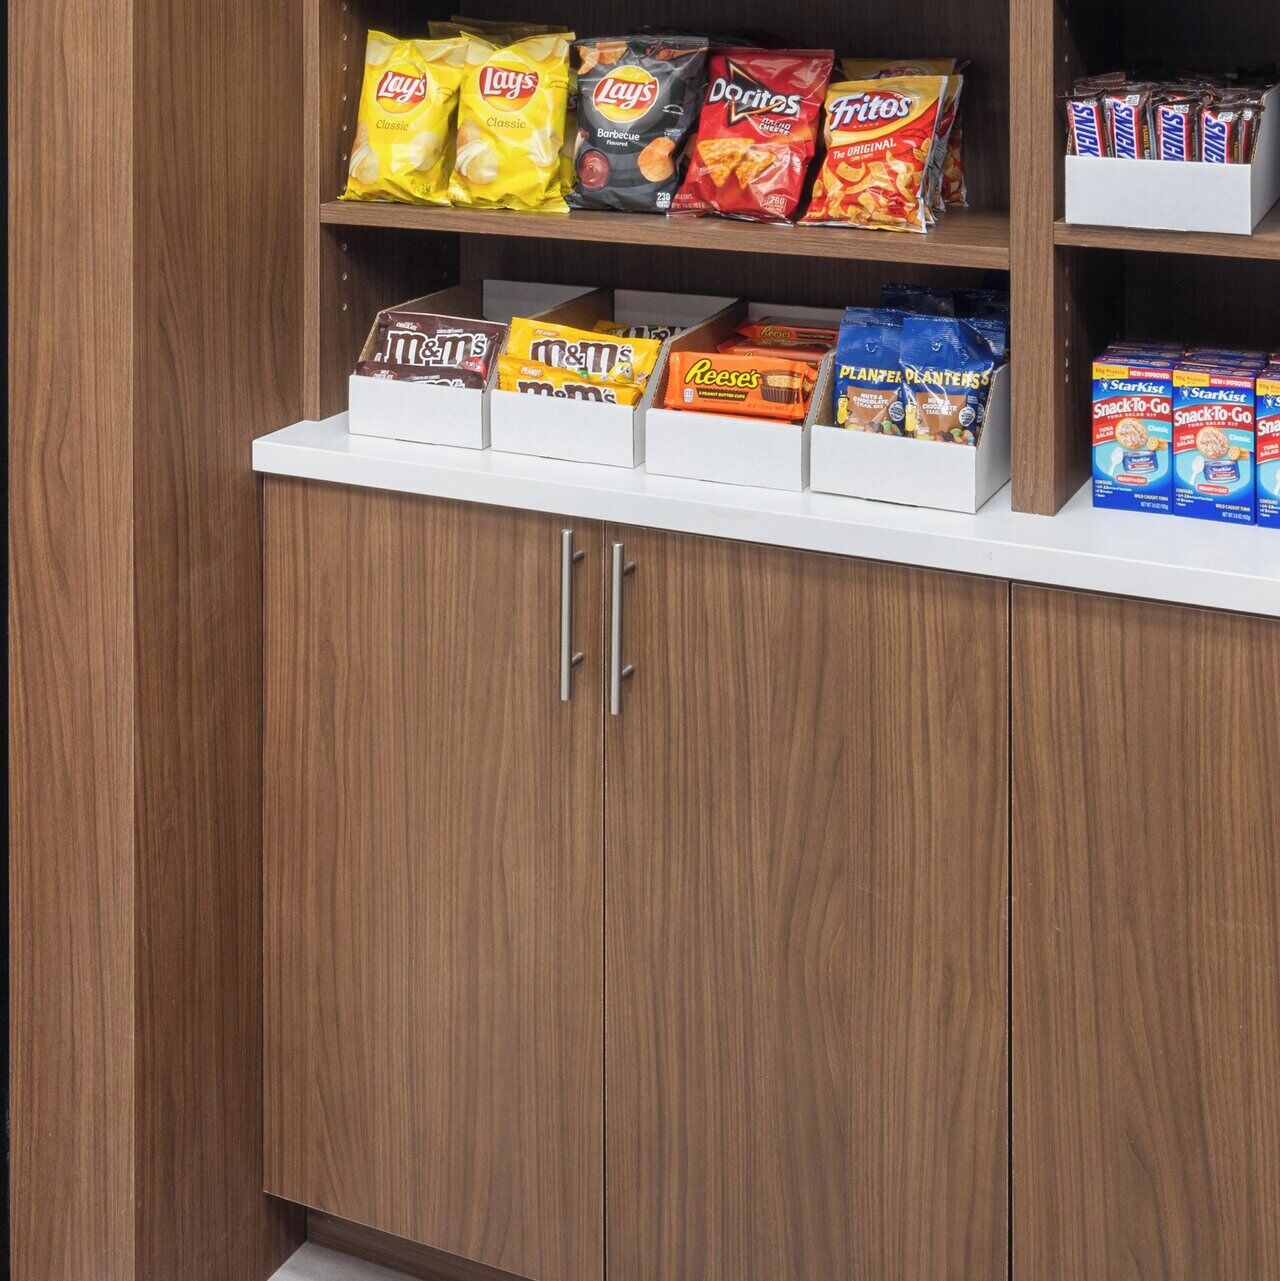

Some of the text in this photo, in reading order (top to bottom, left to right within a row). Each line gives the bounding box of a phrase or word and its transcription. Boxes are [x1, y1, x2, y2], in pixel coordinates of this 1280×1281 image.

[379, 71, 427, 102] Lay's
[483, 67, 537, 98] Lay's
[597, 79, 658, 109] Lay's
[709, 78, 801, 115] Doritos
[830, 93, 912, 130] Fritos
[376, 119, 409, 131] Classic
[487, 117, 526, 129] Classic
[759, 124, 791, 135] CHEESE
[597, 128, 640, 141] Barbecue
[833, 138, 896, 159] The ORIGINAL
[387, 330, 488, 366] m&m's
[530, 338, 632, 373] m&m's
[521, 368, 541, 376] PEANUT
[685, 358, 762, 388] Reese's
[905, 368, 980, 389] PLANTERS
[1110, 380, 1165, 394] StarKist
[1190, 388, 1247, 402] StarKist
[1147, 425, 1169, 434] Classic
